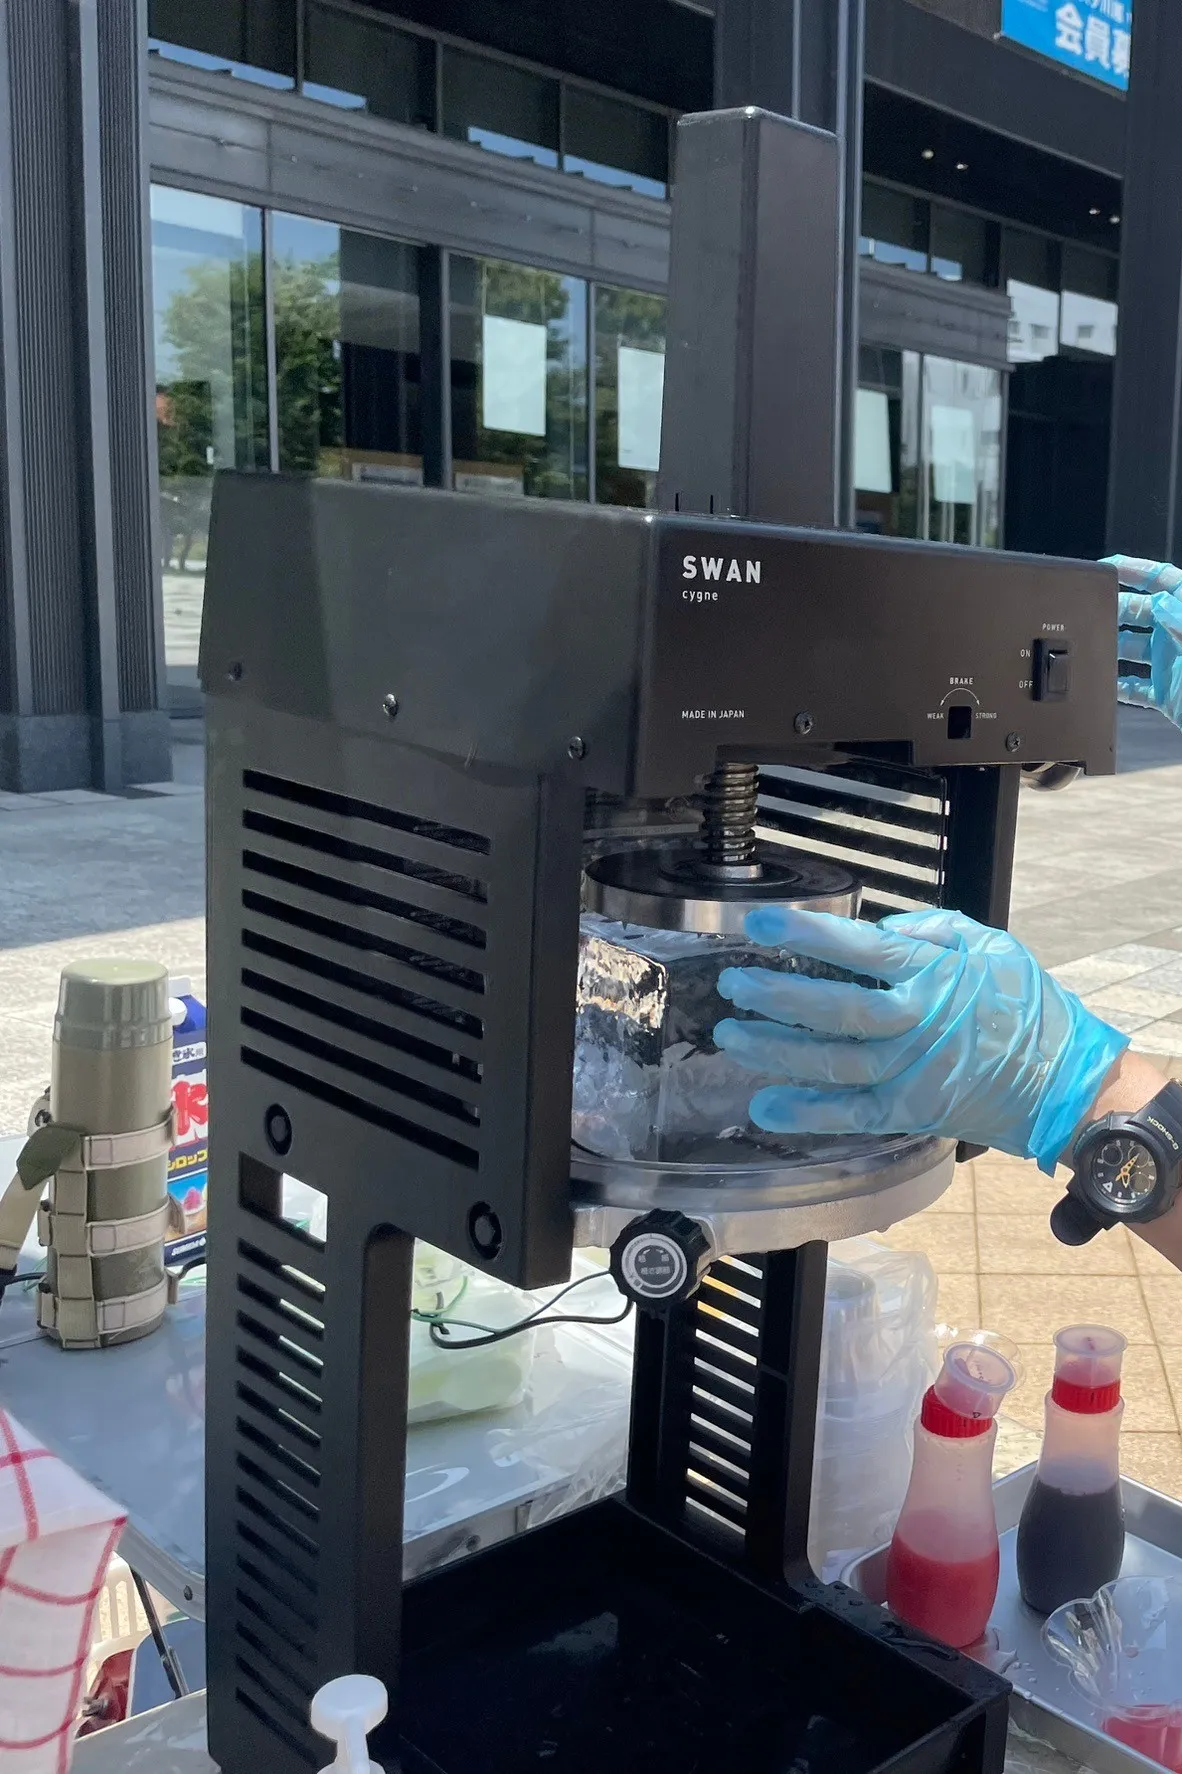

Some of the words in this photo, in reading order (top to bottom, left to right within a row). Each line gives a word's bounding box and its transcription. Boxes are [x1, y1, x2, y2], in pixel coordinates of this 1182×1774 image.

[682, 555, 762, 585] SWAN
[682, 589, 719, 602] cygne
[1042, 623, 1066, 632] POWER
[1020, 649, 1031, 658] ON
[949, 676, 974, 685] BRAKE
[1018, 680, 1033, 689] OFF
[682, 710, 706, 720] MADE
[708, 710, 717, 719] IN
[719, 709, 745, 719] JAPAN
[926, 712, 945, 720] WEAK
[975, 712, 998, 720] STRONG
[1147, 1116, 1179, 1151] G-SHOCK
